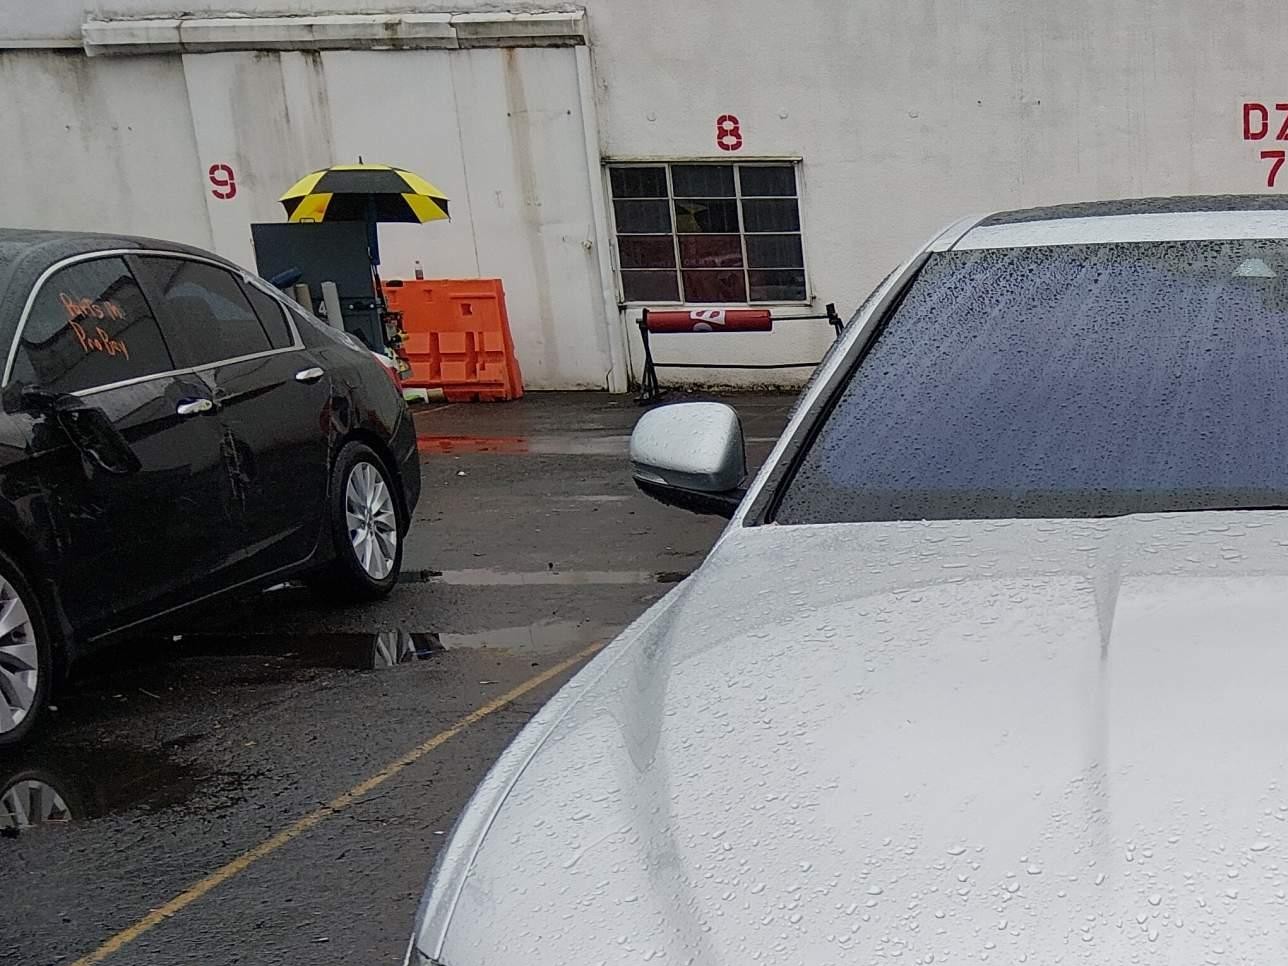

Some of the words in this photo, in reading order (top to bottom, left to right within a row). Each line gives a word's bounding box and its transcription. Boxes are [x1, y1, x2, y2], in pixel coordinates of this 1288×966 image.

[716, 114, 742, 151] 8
[210, 164, 237, 200] 9
[1259, 149, 1287, 187] 7
